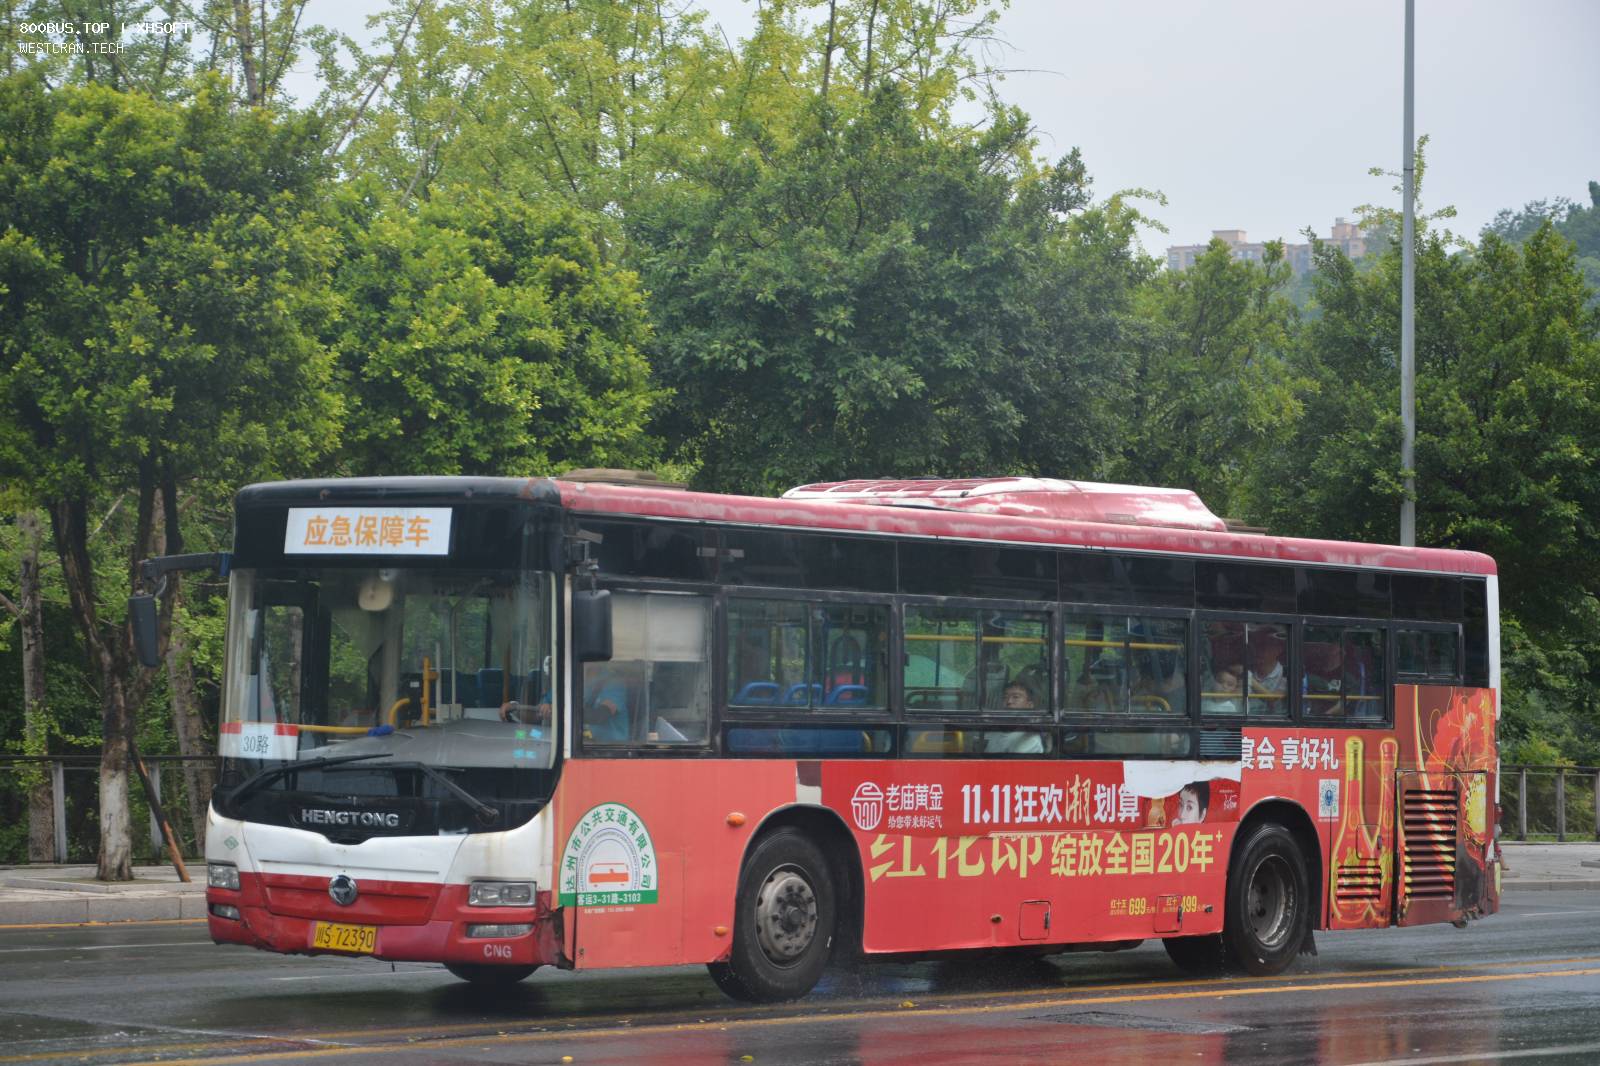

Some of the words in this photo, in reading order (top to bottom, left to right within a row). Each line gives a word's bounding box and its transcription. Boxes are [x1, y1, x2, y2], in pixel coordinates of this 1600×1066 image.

[304, 515, 432, 547] 应急保障车
[243, 735, 269, 753] 30路
[1281, 737, 1339, 771] 享好礼
[886, 783, 944, 811] 老庙黄金
[301, 809, 399, 827] HENGTONG
[1128, 897, 1147, 916] 699
[483, 943, 513, 959] CNG
